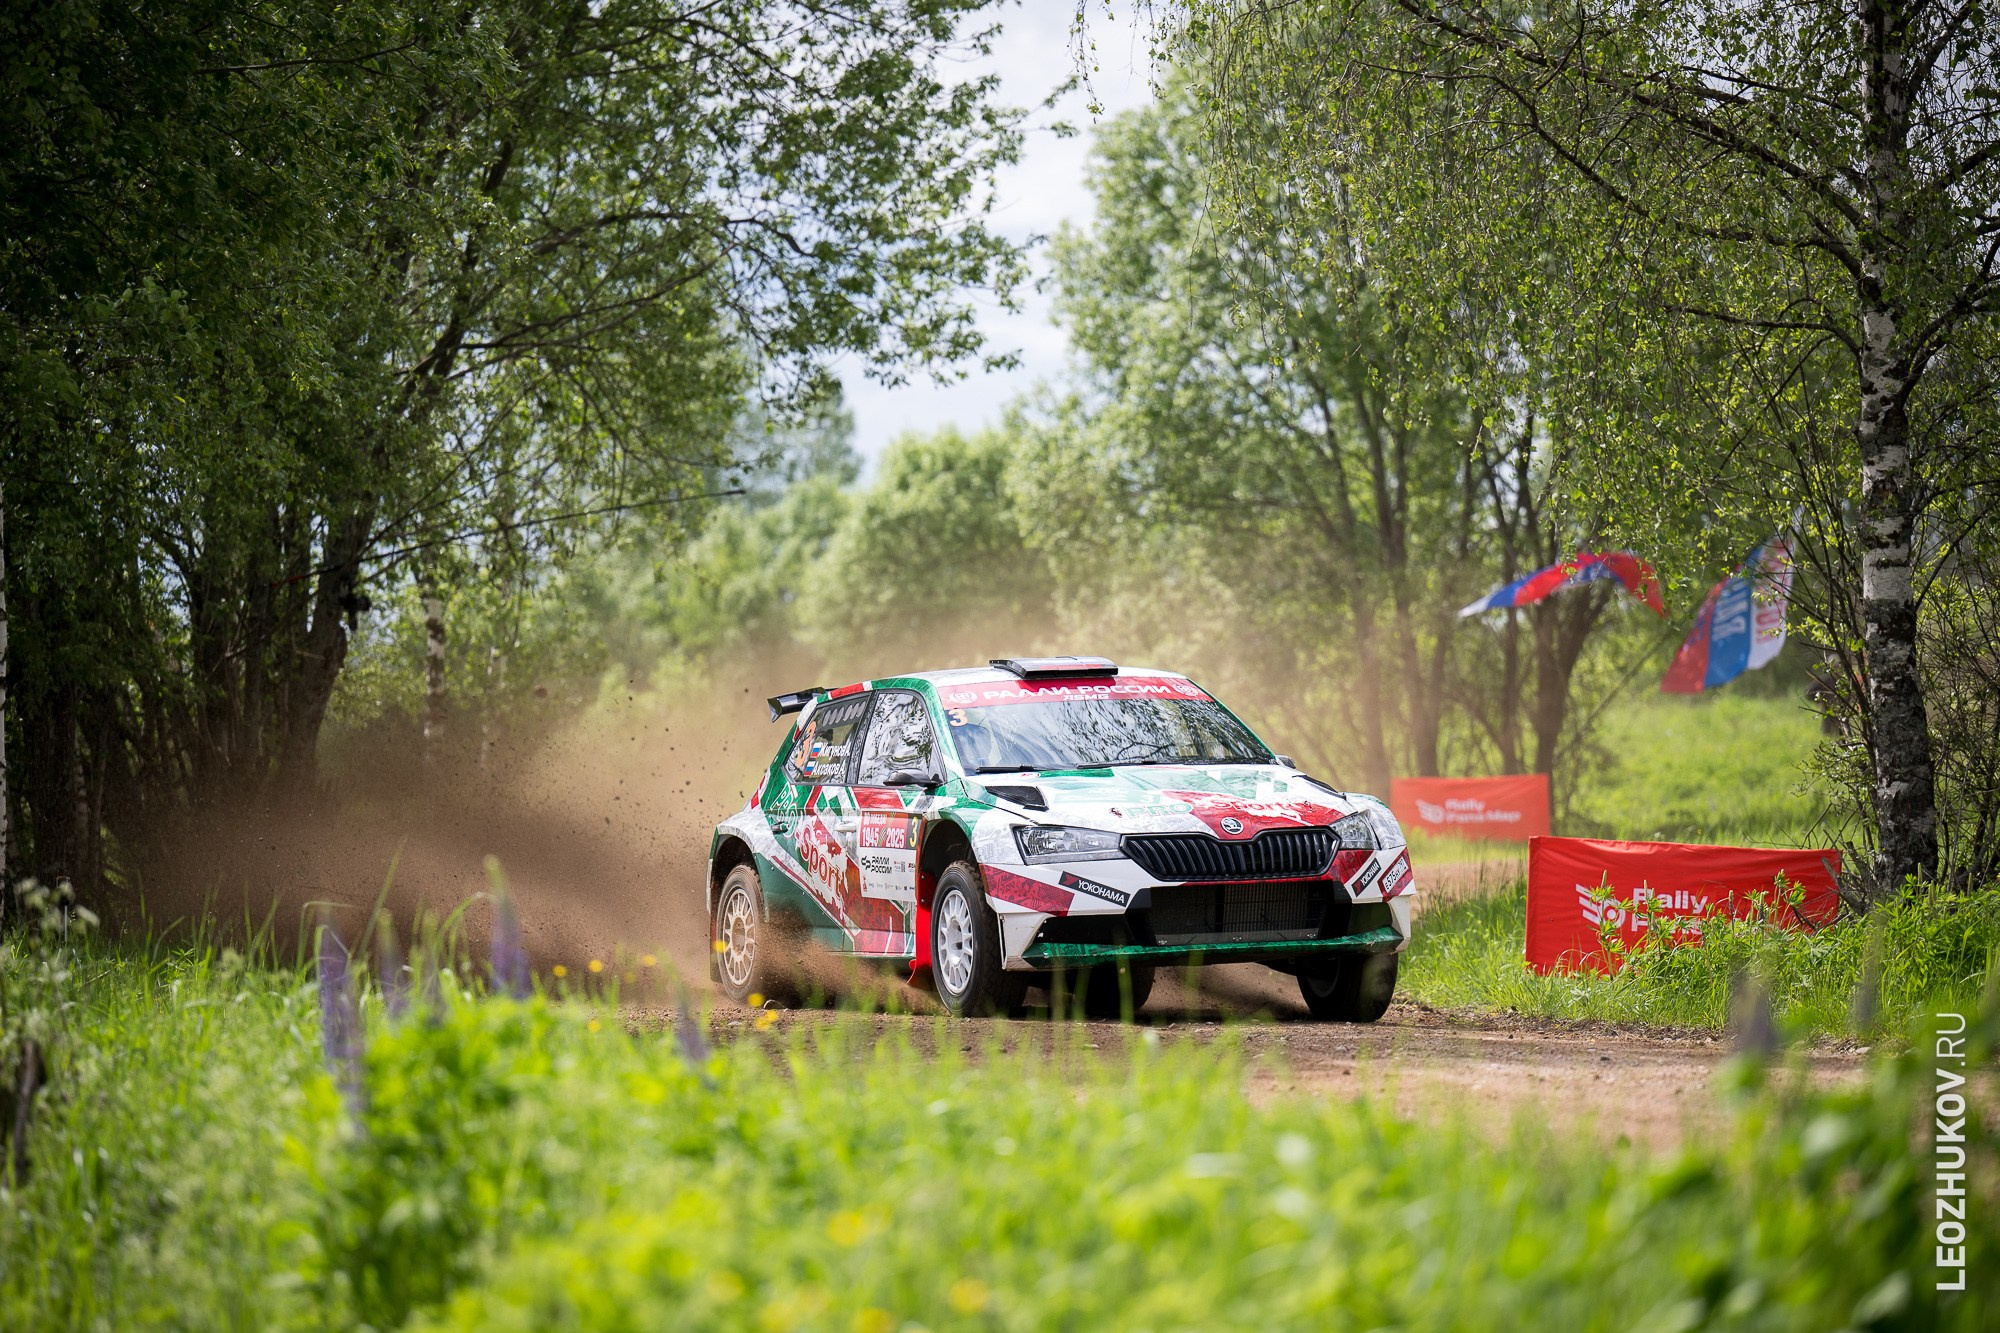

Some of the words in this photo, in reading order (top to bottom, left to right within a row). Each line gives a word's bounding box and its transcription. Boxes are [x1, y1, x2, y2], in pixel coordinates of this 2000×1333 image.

[983, 686, 1071, 700] РАЛЛИ
[1076, 684, 1172, 695] РОССИИ
[948, 709, 968, 727] 3
[795, 721, 817, 769] 3
[1123, 802, 1194, 820] PRO
[862, 827, 879, 847] 1945
[885, 827, 905, 849] 2025
[909, 816, 919, 848] 3
[800, 825, 841, 900] Sport
[1078, 880, 1125, 904] YOKOHAMA
[1632, 887, 1709, 914] Rally
